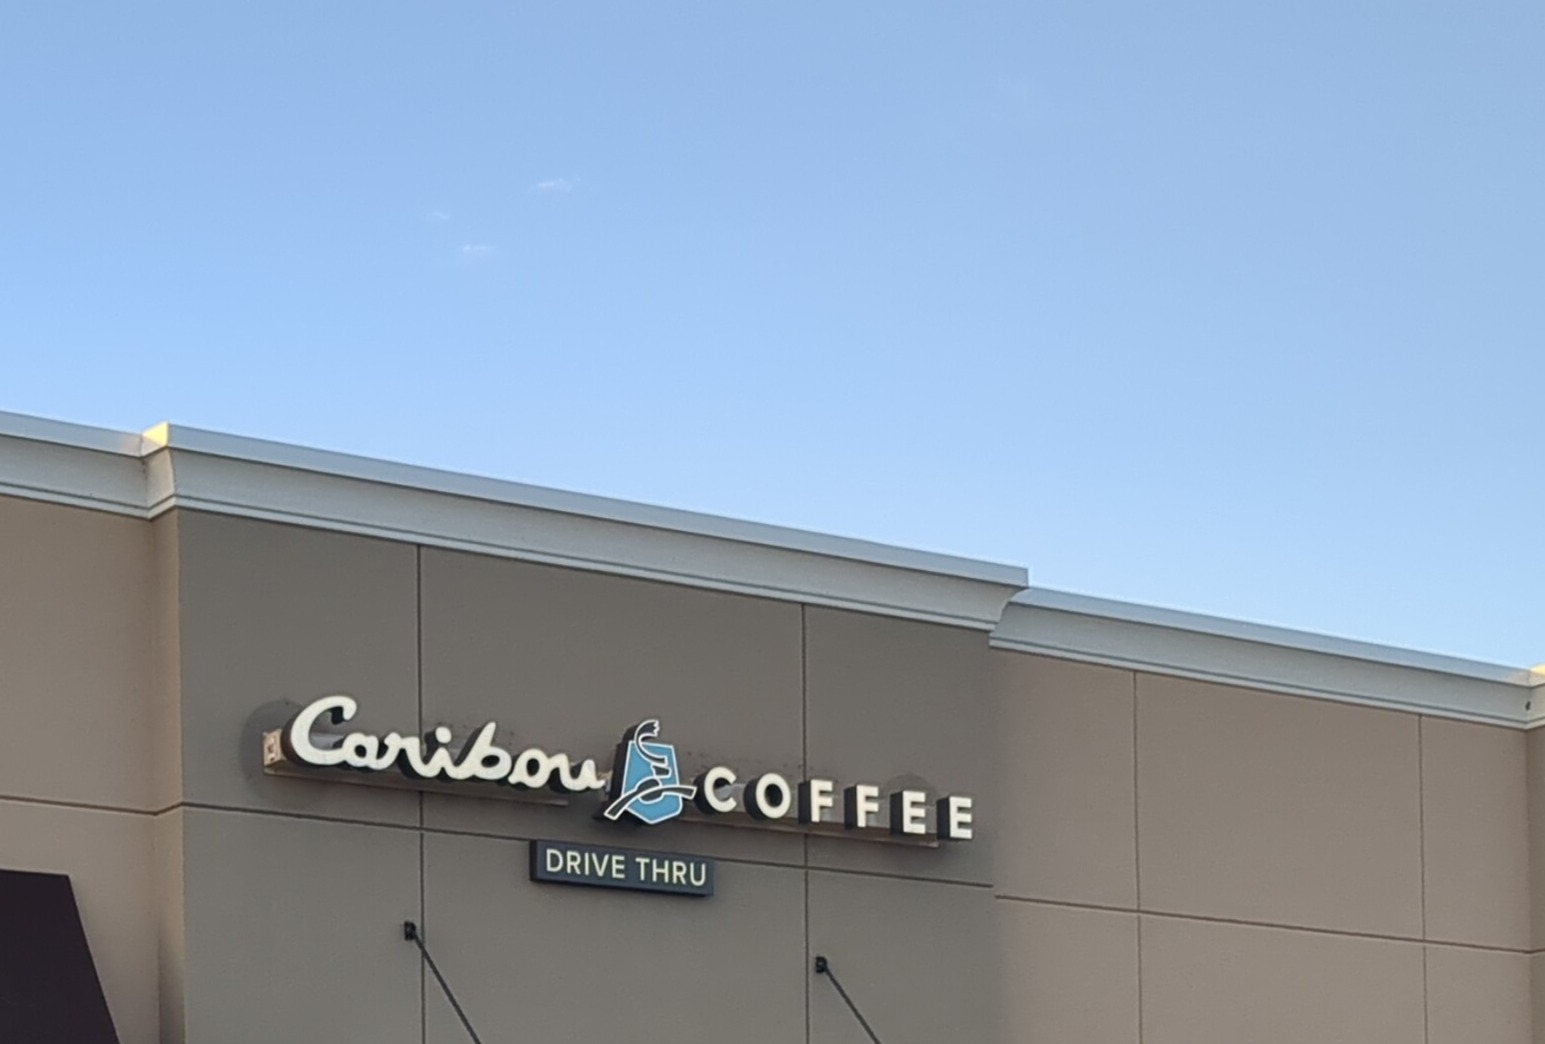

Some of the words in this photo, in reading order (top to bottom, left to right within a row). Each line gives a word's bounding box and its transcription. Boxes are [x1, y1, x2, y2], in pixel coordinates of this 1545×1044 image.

[290, 695, 606, 792] Caribou
[703, 766, 973, 840] COFFEE
[546, 848, 626, 879] DRIVE
[635, 857, 707, 887] THRU
